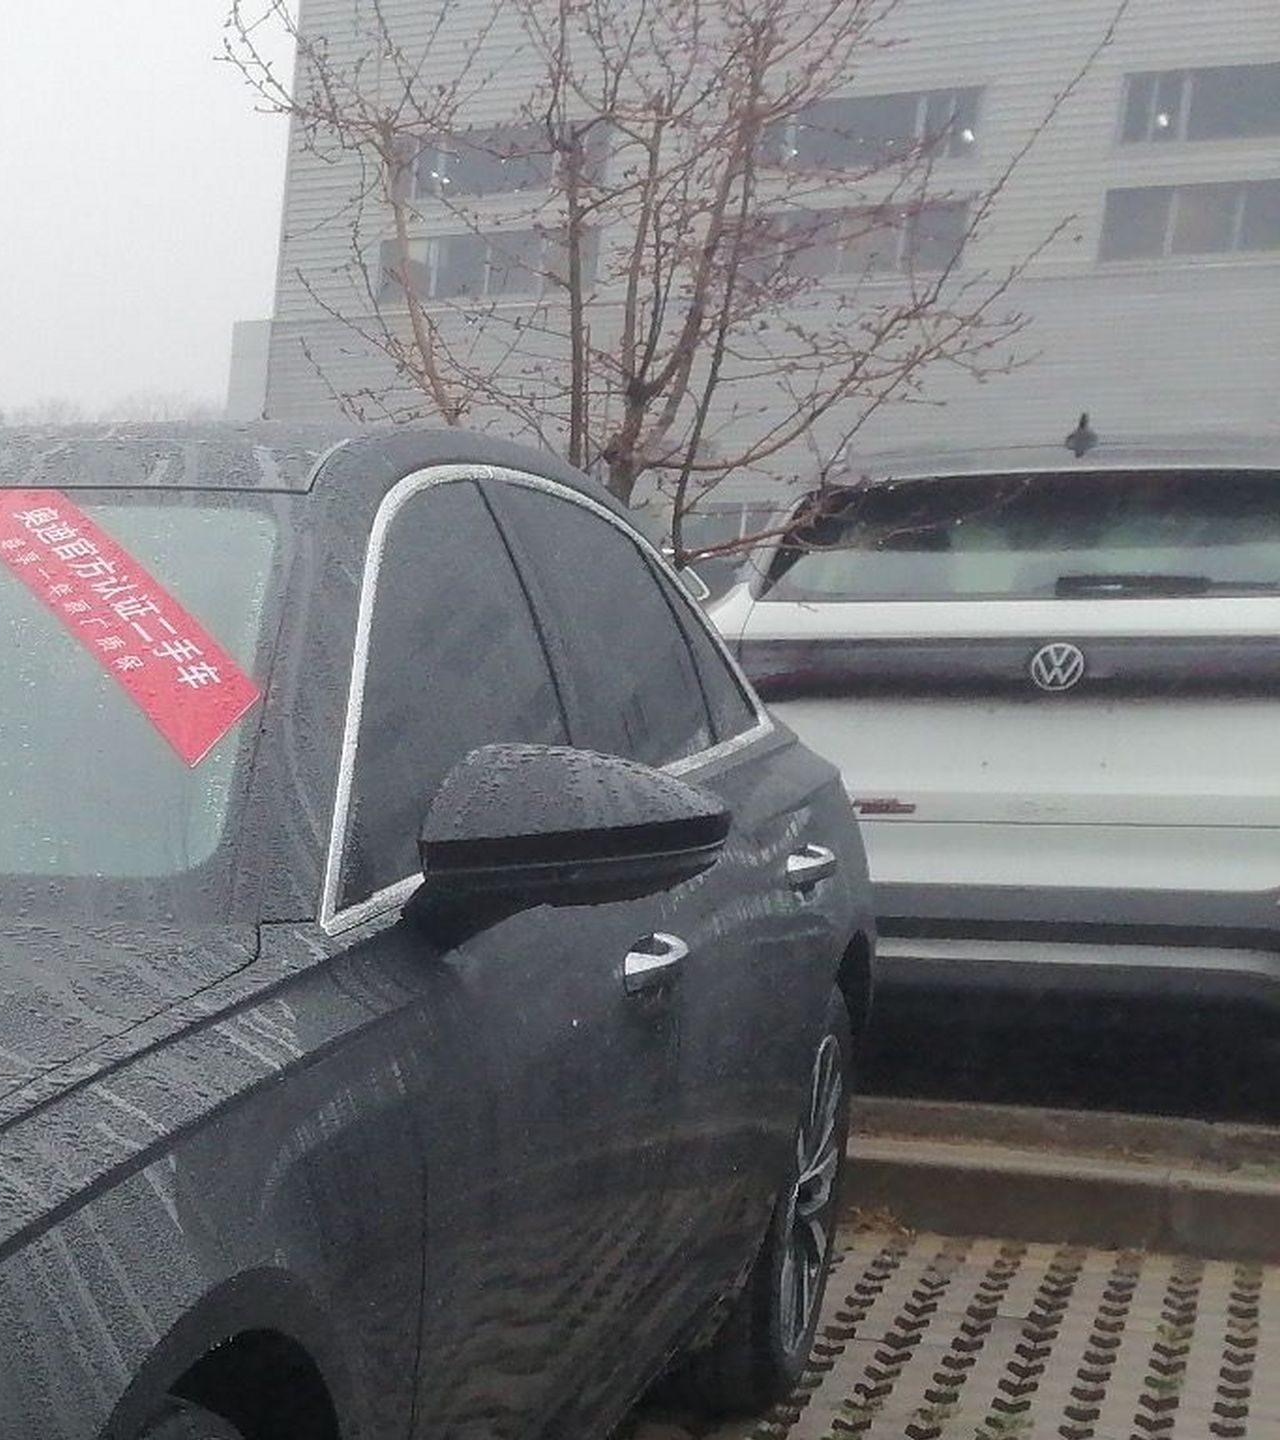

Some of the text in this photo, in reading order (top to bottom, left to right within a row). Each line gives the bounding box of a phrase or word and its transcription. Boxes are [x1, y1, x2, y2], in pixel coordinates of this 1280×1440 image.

[12, 506, 222, 690] 奥迪官方认证二手车
